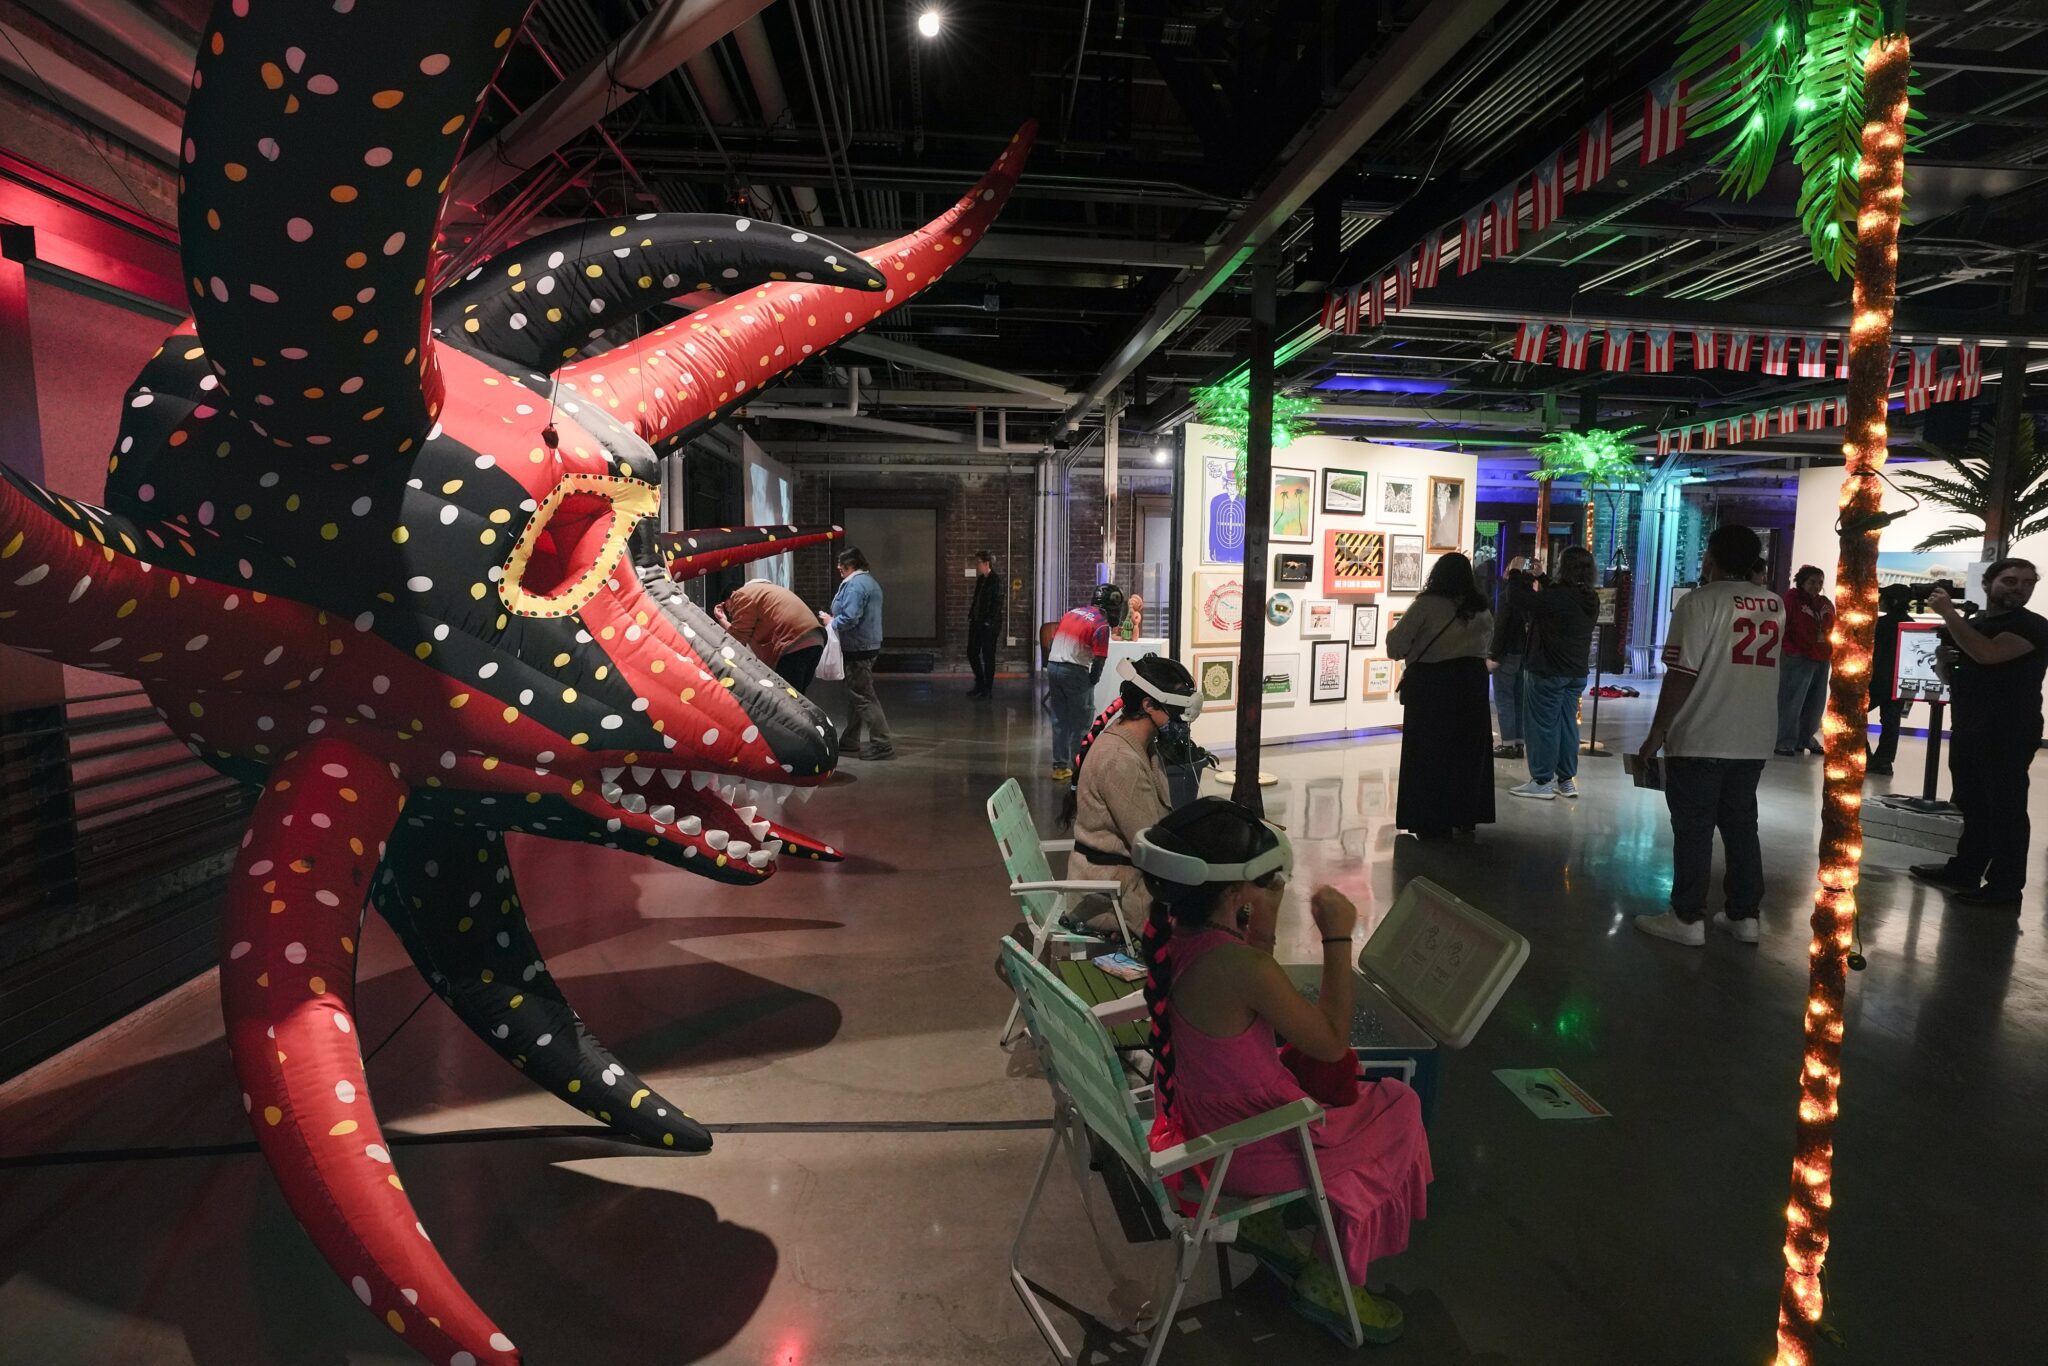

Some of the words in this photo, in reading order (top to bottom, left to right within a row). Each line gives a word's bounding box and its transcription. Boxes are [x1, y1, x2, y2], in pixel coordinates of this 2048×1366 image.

[1985, 546, 1996, 561] 2
[1733, 596, 1779, 612] SOTO
[1731, 617, 1779, 667] 22
